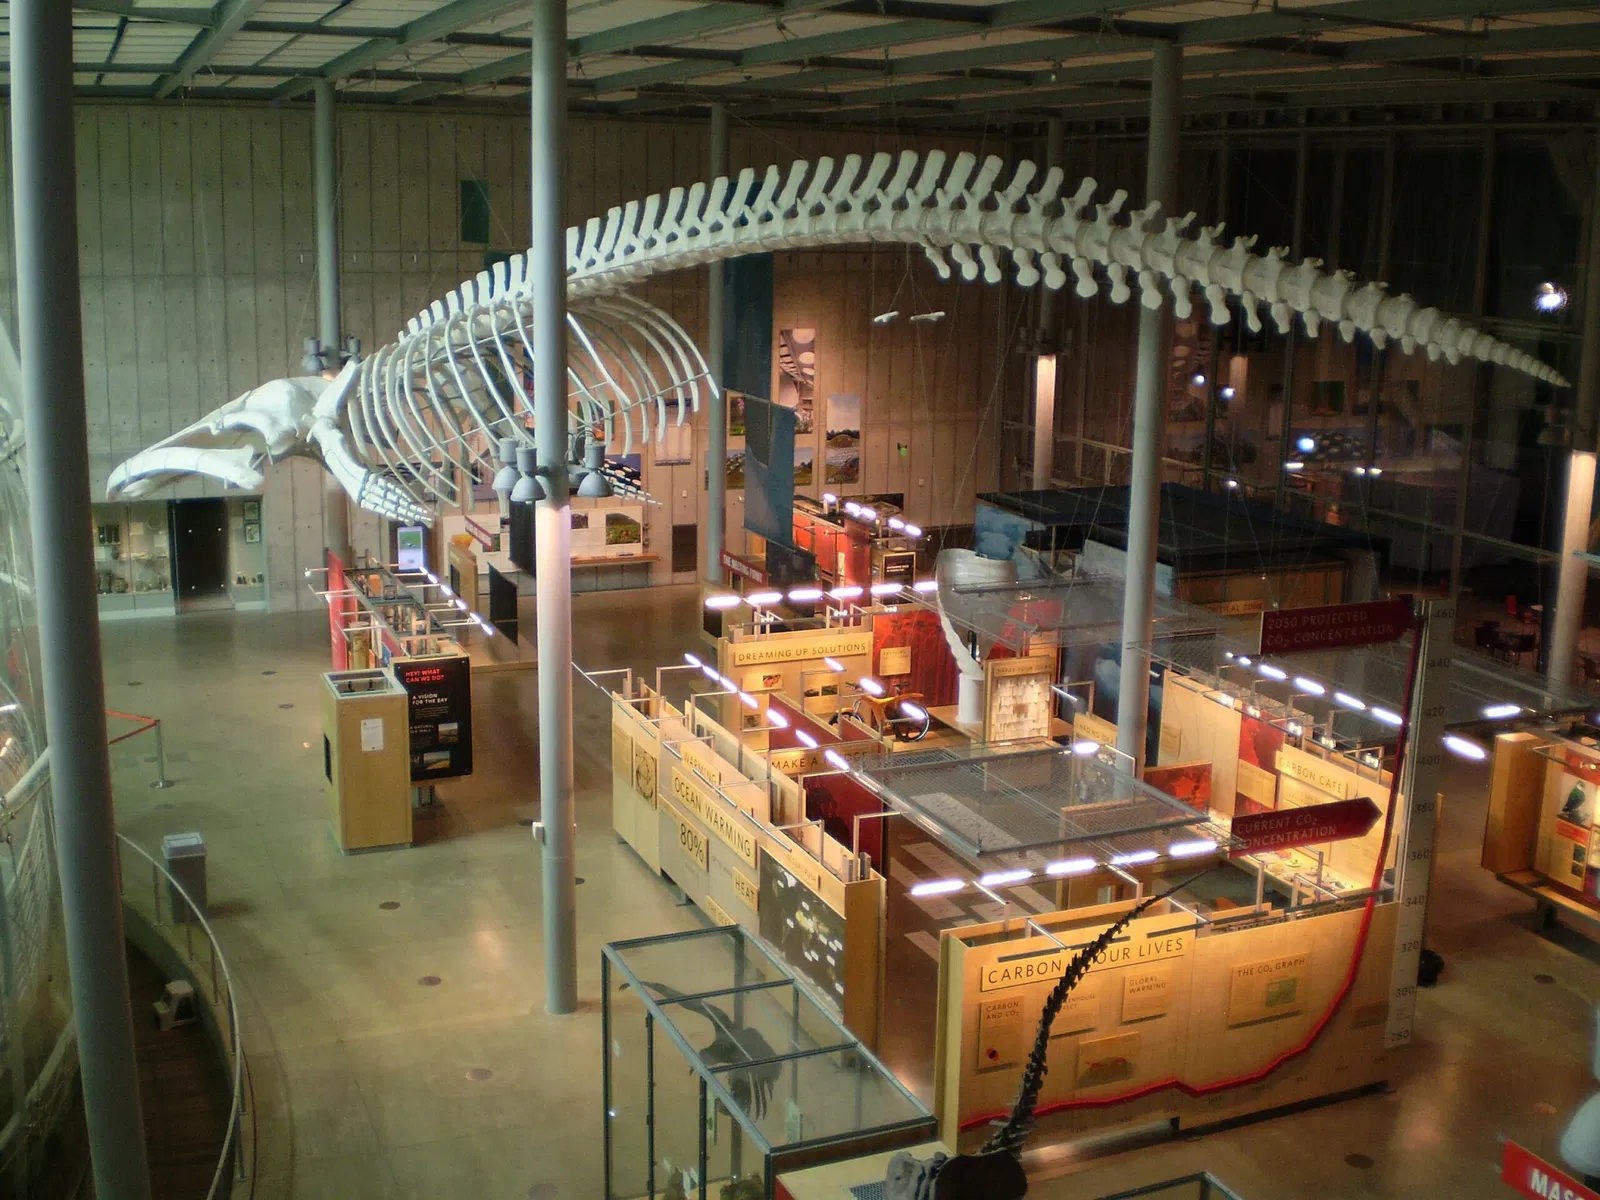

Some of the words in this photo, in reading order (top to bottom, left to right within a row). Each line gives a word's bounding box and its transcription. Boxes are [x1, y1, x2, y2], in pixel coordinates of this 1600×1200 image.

[1268, 617, 1298, 630] 2050
[1302, 610, 1368, 626] PROJECTED
[1294, 624, 1394, 643] CONCENTRATION
[738, 649, 792, 662] DREAMING
[796, 648, 809, 658] UP
[812, 643, 867, 656] SOLUTIONS
[771, 758, 805, 770] MAKE
[811, 756, 819, 765] A
[1279, 757, 1316, 781] CARBON
[674, 777, 702, 813] OCEAN
[705, 804, 751, 857] WARMING
[1236, 816, 1291, 834] CURRENT
[680, 823, 704, 862] 80%
[1241, 824, 1337, 848] ONCENTRATION
[1411, 849, 1430, 861] 360
[735, 876, 755, 905] HEAT
[1406, 895, 1425, 908] 340
[1402, 941, 1419, 953] 320
[988, 959, 1062, 984] CARBON
[1096, 947, 1131, 964] OUR
[1139, 937, 1183, 958] LIVES
[1237, 967, 1254, 977] THE
[1275, 959, 1305, 972] GRAPH
[1128, 982, 1167, 994] WARMING
[1129, 976, 1158, 986] GLOBAL
[986, 1001, 1019, 1012] CARBON
[986, 1011, 1004, 1020] AND
